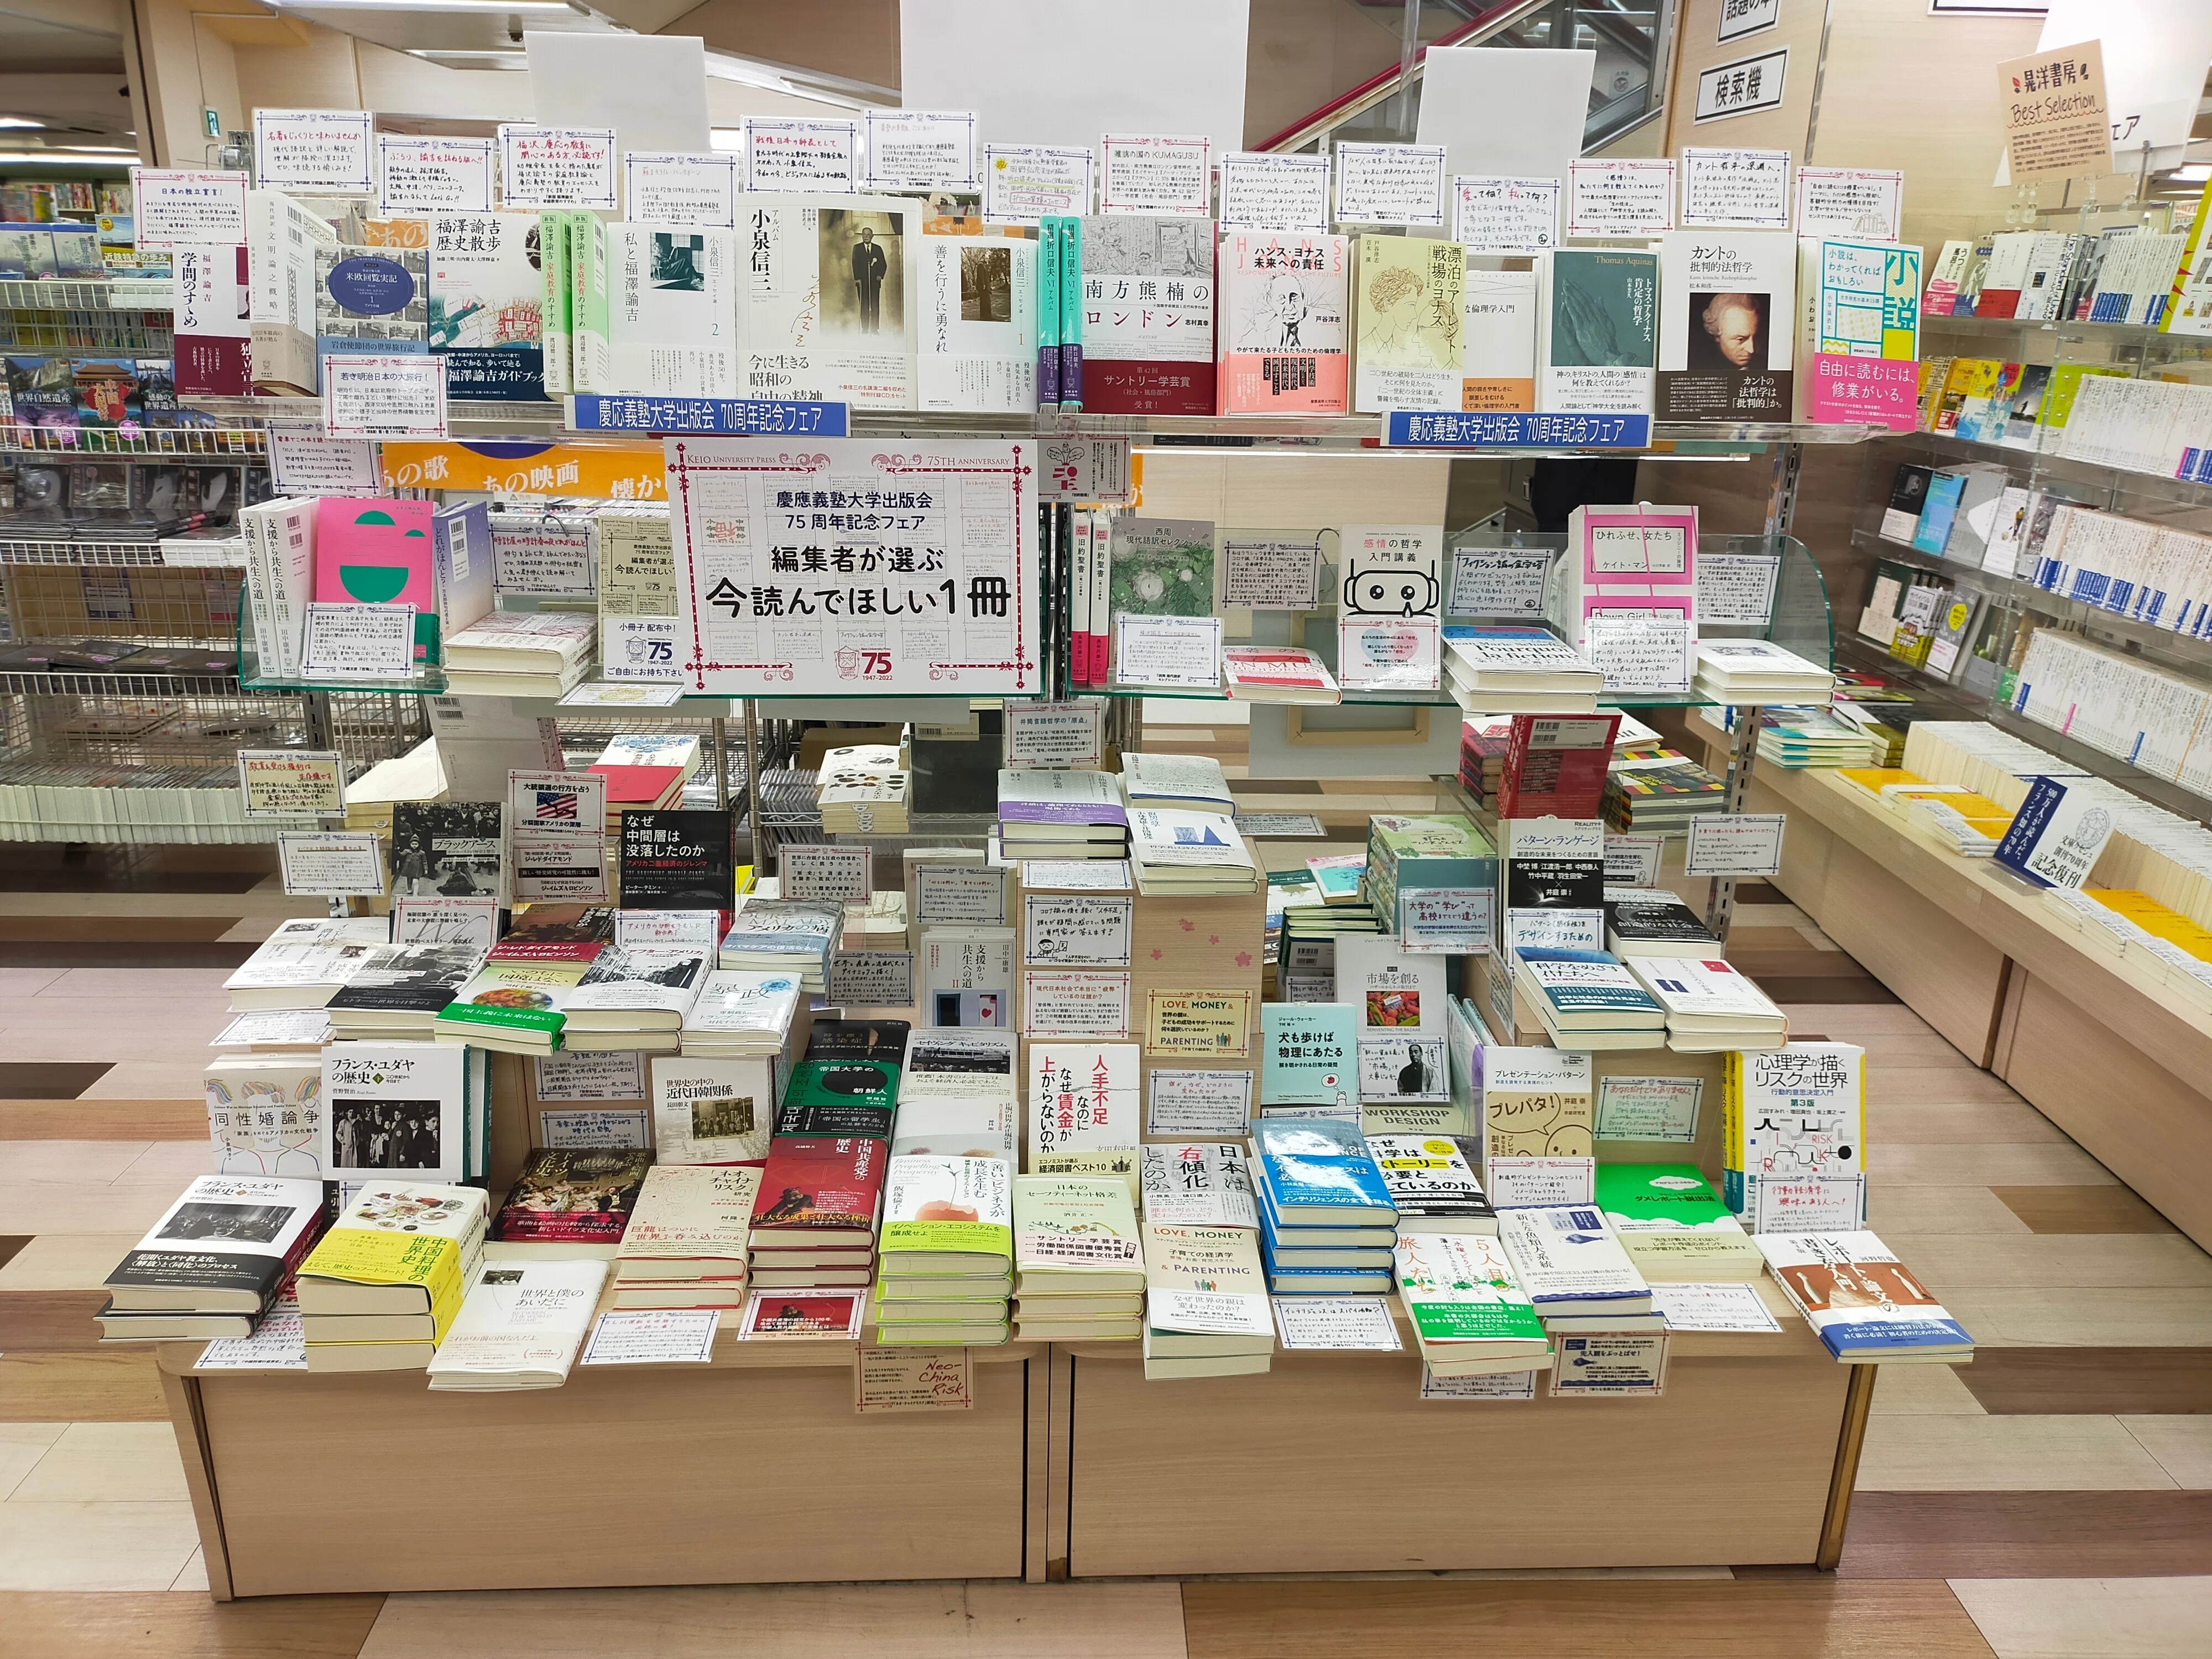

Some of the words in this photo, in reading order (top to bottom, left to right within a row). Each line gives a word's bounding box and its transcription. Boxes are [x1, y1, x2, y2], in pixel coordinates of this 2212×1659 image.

[2023, 59, 2077, 94] 晃洋書房
[1715, 65, 1762, 108] 検索機
[2010, 100, 2042, 123] Best
[2044, 91, 2096, 116] Selection
[1152, 152, 1199, 160] KUMAGUSU
[435, 218, 502, 236] 福澤諭吉
[435, 236, 502, 253] 歴史散歩
[749, 208, 771, 291] 小泉信三
[1254, 247, 1324, 258] ハンス・ヨナス
[1690, 245, 1737, 261] カントの
[1254, 258, 1324, 270] 未来への責任
[1594, 255, 1625, 265] Thomas
[1625, 257, 1653, 267] Aquinas
[1689, 260, 1753, 274] 批判的法哲学
[267, 231, 278, 310] 文明論之概略
[1828, 262, 1881, 276] わかってくれば
[202, 254, 212, 303] 福澤諭吉
[345, 272, 398, 284] 米欧回覧実記
[623, 232, 639, 323] 私と福澤諭吉
[1828, 274, 1864, 287] おもしろい
[1086, 279, 1209, 302] 南方熊楠の
[1431, 244, 1447, 327] 戦場のヨナス
[1884, 251, 1918, 329] 小説
[933, 244, 948, 353] 善を行うに勇なれ
[1447, 245, 1462, 354] 漂泊のアーレント
[1632, 278, 1644, 326] 肯定の哲学
[1086, 309, 1183, 328] ロンドン
[1185, 318, 1209, 326] 志村真幸
[1315, 315, 1340, 324] 戸谷洋志
[331, 340, 415, 353] 岩倉使節団の世界旅行記
[1236, 346, 1342, 355] やがて来たる子どもたちのための倫理学
[748, 354, 810, 370] 今に生きる
[1819, 360, 1915, 384] 自由に読むには、
[749, 371, 792, 387] 昭和の
[1104, 375, 1191, 388] サントリー学芸賞
[1743, 375, 1775, 387] カントの
[1738, 386, 1777, 398] 法哲学は
[1831, 381, 1904, 403] 修業がいる。
[598, 399, 714, 430] 慶応義塾大学出版会
[721, 402, 822, 432] 70周年記念フェア
[1408, 415, 1520, 444] 慶応義塾大学出版会
[1526, 416, 1625, 444] 70周年記念フェア
[686, 454, 712, 465] KEIO
[713, 455, 754, 465] UNIVERSITY
[755, 455, 777, 463] PRESS
[927, 456, 956, 467] 75TH
[958, 456, 1010, 466] ANNIVERSARY
[776, 491, 933, 509] 慶應義塾大学出版会
[1155, 528, 1171, 536] 西周
[1595, 531, 1672, 541] ひれふせ、女たち
[1126, 535, 1201, 546] 現代語訳セレクション
[1363, 538, 1423, 550] 感情の哲学
[243, 518, 265, 600] 支援から共生への道
[265, 518, 286, 601] 支援から共生への道
[770, 546, 944, 573] 編集者が選ぶ
[1077, 539, 1086, 573] 旧約聖書
[1097, 543, 1105, 577] 旧約聖書
[1368, 552, 1417, 563] 入門講義
[1602, 560, 1649, 570] ケイト・マン
[705, 577, 1011, 619] 今読んでほしい1冊
[619, 623, 645, 633] 小冊子
[648, 641, 672, 660] 75
[861, 651, 893, 675] 75
[523, 783, 590, 793] 大統領選の行方を占う
[626, 815, 655, 827] なぜ
[625, 830, 680, 843] 中間層は
[1516, 835, 1600, 846] パターン・ランゲージ
[434, 839, 496, 849] ブラックアース
[625, 844, 705, 857] 没落したのか
[2031, 852, 2082, 889] 記念復刊
[961, 944, 973, 989] 共生への道
[975, 944, 986, 982] 支援から
[1366, 973, 1419, 985] 市場を創る
[1191, 1000, 1227, 1009] MONEY
[1160, 1037, 1213, 1046] PARENTING
[1278, 1031, 1334, 1044] 犬も歩けば
[1278, 1047, 1343, 1058] 物理にあたる
[331, 1059, 415, 1072] フランス・ユダヤ
[1754, 1055, 1845, 1071] 心理学が描く
[1495, 1069, 1586, 1079] プレゼンテーション・パターン
[1754, 1071, 1849, 1089] リスクの世界
[666, 1078, 714, 1087] 世界史の中の
[666, 1086, 734, 1099] 近代日韓関係
[1092, 1054, 1109, 1125] 人手不足
[1039, 1056, 1056, 1154] 上がらないのか
[1057, 1067, 1074, 1142] なぜ賃金が
[1790, 1099, 1815, 1107] 第3版
[214, 1109, 320, 1126] 同性婚論争
[1076, 1095, 1089, 1131] なのに
[1365, 1109, 1450, 1118] WORKSHOP
[1391, 1117, 1441, 1126] DESIGN
[1811, 1134, 1834, 1144] RISK
[836, 1139, 851, 1154] 歴史
[853, 1139, 873, 1181] 中国共産党の
[1036, 1235, 1122, 1245] サントリー学芸賞
[1194, 1230, 1243, 1240] MONEY
[1036, 1241, 1122, 1253] 労働関係図書優秀賞
[1168, 1249, 1233, 1259] 子育ての経済学
[1174, 1264, 1251, 1275] PARENTING
[520, 1288, 585, 1299] 世界と僕の
[515, 1297, 567, 1306] あいだに
[918, 1371, 959, 1383] China
[931, 1383, 964, 1396] Risk
